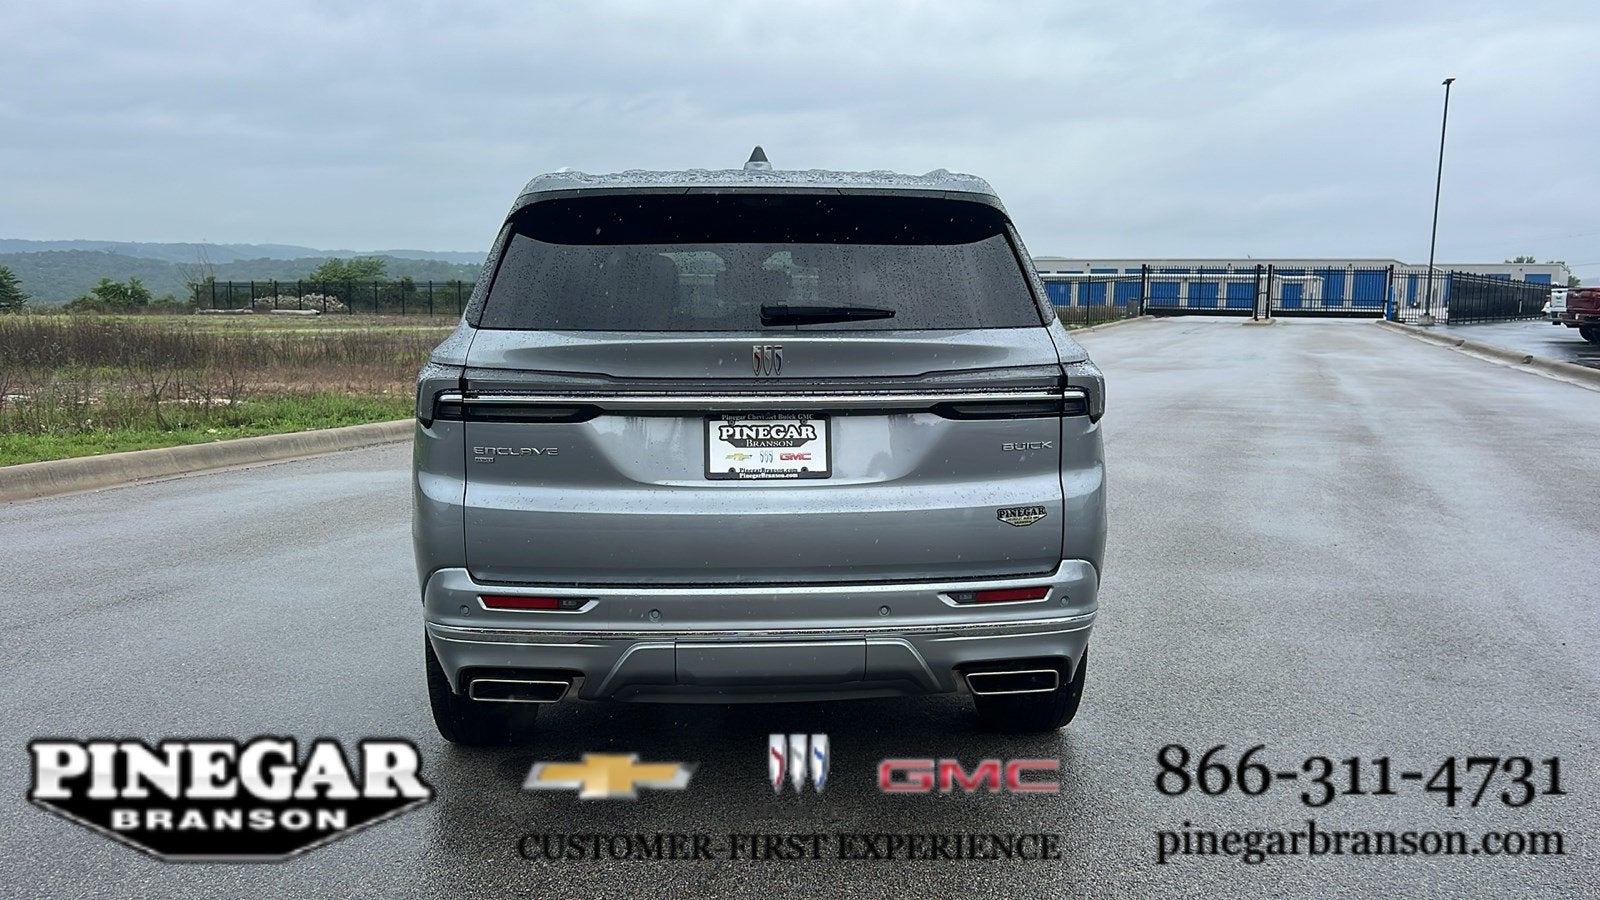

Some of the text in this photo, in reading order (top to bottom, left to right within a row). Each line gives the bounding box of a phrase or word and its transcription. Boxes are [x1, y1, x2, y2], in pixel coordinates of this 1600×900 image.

[719, 425, 816, 440] PINEGAR
[746, 439, 793, 447] BRANSON
[1002, 441, 1053, 451] BUICK
[473, 446, 559, 456] ENCLAVE
[779, 452, 812, 461] GMC
[998, 507, 1046, 518] PINEGAR
